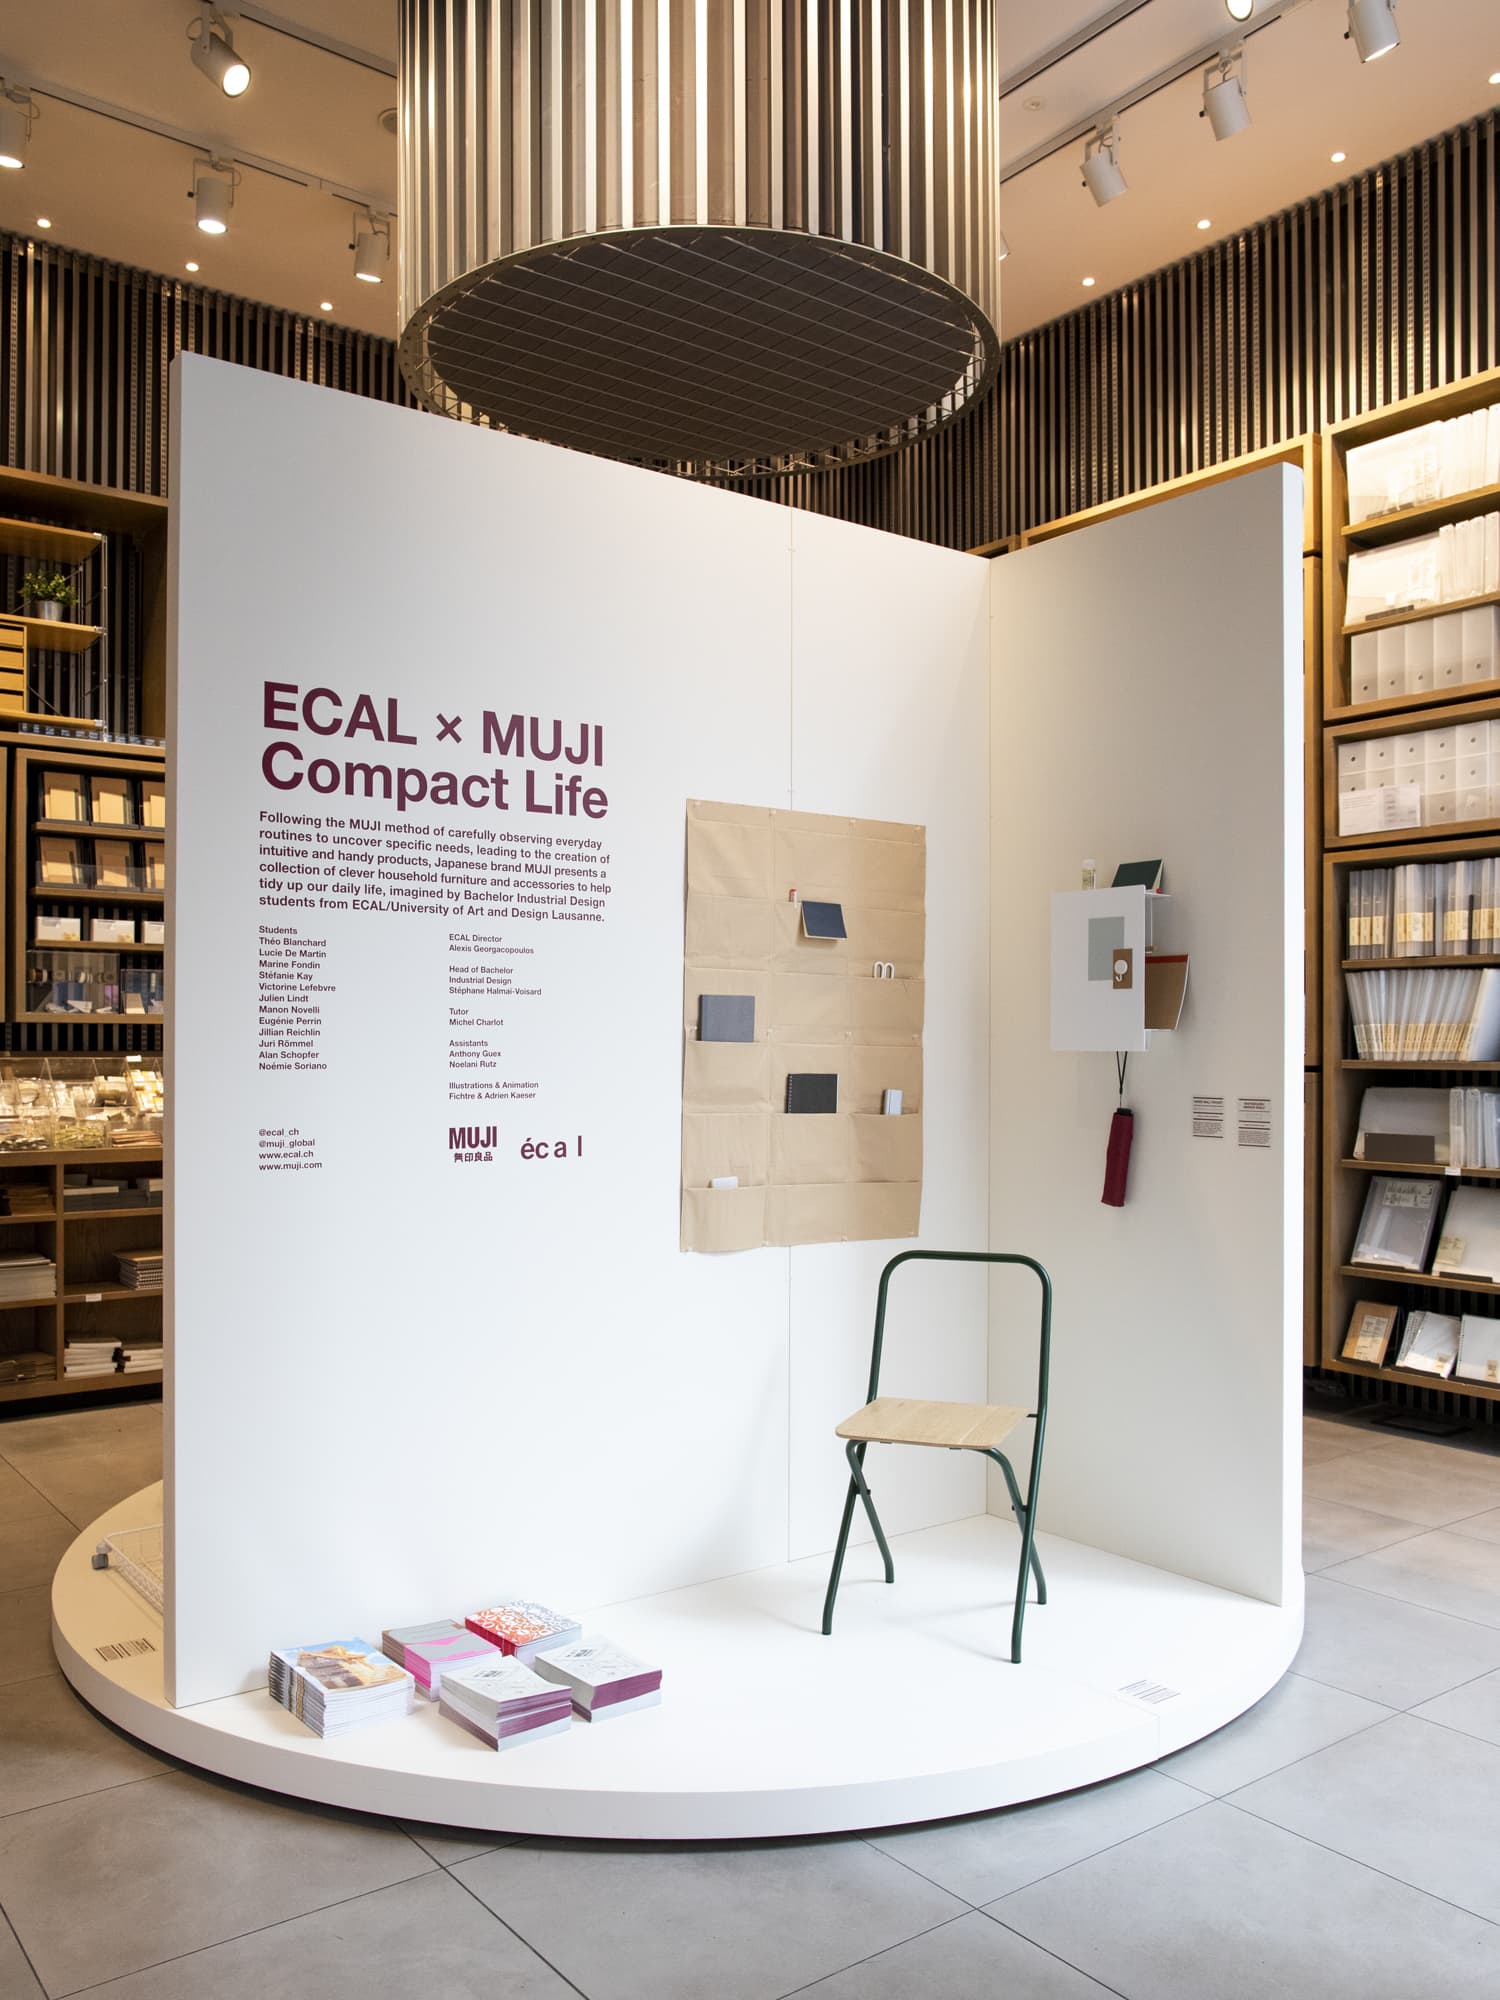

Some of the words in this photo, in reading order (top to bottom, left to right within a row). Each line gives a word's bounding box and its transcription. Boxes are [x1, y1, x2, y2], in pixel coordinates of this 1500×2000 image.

[264, 681, 417, 745] ECAL
[483, 711, 602, 767] MUJI
[262, 741, 509, 812] Compact
[526, 770, 608, 819] Life
[260, 811, 321, 829] Following
[326, 817, 345, 828] the
[350, 818, 380, 831] MUJI
[385, 824, 429, 835] method
[433, 826, 445, 836] of
[448, 829, 496, 842] carefully
[500, 832, 552, 847] observing
[556, 838, 602, 851] everyday
[259, 829, 312, 842] routines
[316, 832, 328, 843] to
[333, 836, 382, 847] uncover
[386, 840, 432, 851] specific
[436, 843, 473, 856] needs,
[477, 844, 517, 859] leading
[520, 849, 531, 858] to
[535, 849, 551, 859] the
[555, 852, 597, 863] creation
[600, 854, 610, 864] of
[260, 844, 308, 858] intuitive
[312, 849, 334, 860] and
[338, 850, 374, 864] handy
[377, 854, 431, 868] products,
[434, 857, 488, 870] Japanese
[491, 861, 521, 872] brand
[525, 863, 551, 874] MUJI
[554, 868, 598, 877] presents
[601, 870, 606, 879] a
[259, 862, 320, 875] collection
[324, 866, 336, 876] of
[339, 867, 375, 879] clever
[378, 869, 437, 882] household
[440, 873, 487, 885] furniture
[490, 877, 510, 887] and
[513, 880, 575, 891] accessories
[577, 882, 587, 892] to
[590, 883, 611, 895] help
[259, 878, 283, 892] tidy
[287, 882, 303, 892] up
[307, 883, 328, 892] our
[332, 882, 361, 896] daily
[365, 884, 386, 897] life,
[390, 885, 443, 899] imagined
[447, 889, 460, 902] by
[464, 890, 514, 902] Bachelor
[517, 893, 566, 905] Industrial
[570, 896, 605, 909] Design
[259, 895, 315, 908] students
[319, 897, 348, 909] from
[353, 899, 449, 916] ECAL/University
[453, 905, 464, 915] of
[467, 906, 484, 916] Art
[488, 907, 508, 917] and
[512, 908, 548, 921] Design
[552, 910, 604, 922] Lausanne.
[259, 925, 297, 934] Students
[283, 938, 326, 947] Blanchard
[449, 933, 470, 942] ECAL
[472, 933, 502, 943] Director
[259, 947, 282, 957] Lucie
[285, 948, 297, 958] De
[299, 949, 326, 959] Martin
[449, 943, 471, 953] Alexis
[259, 959, 289, 969] Marine
[292, 960, 320, 970] Fondin
[449, 964, 469, 974] Head
[471, 965, 478, 974] of
[481, 965, 513, 975] Bachelor
[297, 972, 313, 982] Kay
[449, 976, 484, 985] Industrial
[486, 976, 512, 986] Design
[259, 982, 297, 992] Victorine
[300, 983, 336, 993] Lefebvre
[259, 993, 284, 1003] Julien
[287, 993, 308, 1003] Lindt
[259, 1004, 288, 1014] Manon
[291, 1005, 319, 1015] Novelli
[449, 1007, 469, 1016] Tutor
[259, 1016, 294, 1026] Eugénie
[296, 1016, 321, 1026] Perrin
[449, 1017, 474, 1027] Michel
[259, 1027, 284, 1037] Jillian
[287, 1027, 320, 1037] Reichlin
[259, 1039, 275, 1048] Juri
[449, 1039, 488, 1048] Assistants
[259, 1050, 278, 1060] Alan
[281, 1051, 320, 1060] Schopfer
[449, 1050, 480, 1059] Anthony
[482, 1049, 501, 1058] Guex
[259, 1061, 292, 1071] Noémie
[294, 1061, 327, 1071] Soriano
[480, 1059, 496, 1068] Rutz
[449, 1081, 493, 1090] Illustrations
[495, 1081, 500, 1089] &
[502, 1080, 539, 1089] Animation
[449, 1091, 475, 1101] Fichtre
[477, 1091, 482, 1100] &
[485, 1091, 508, 1100] Adrien
[511, 1091, 536, 1100] Kaeser
[449, 1126, 497, 1150] MUJI
[259, 1150, 313, 1160] www.ecal.ch
[259, 1161, 322, 1171] www.muji.com
